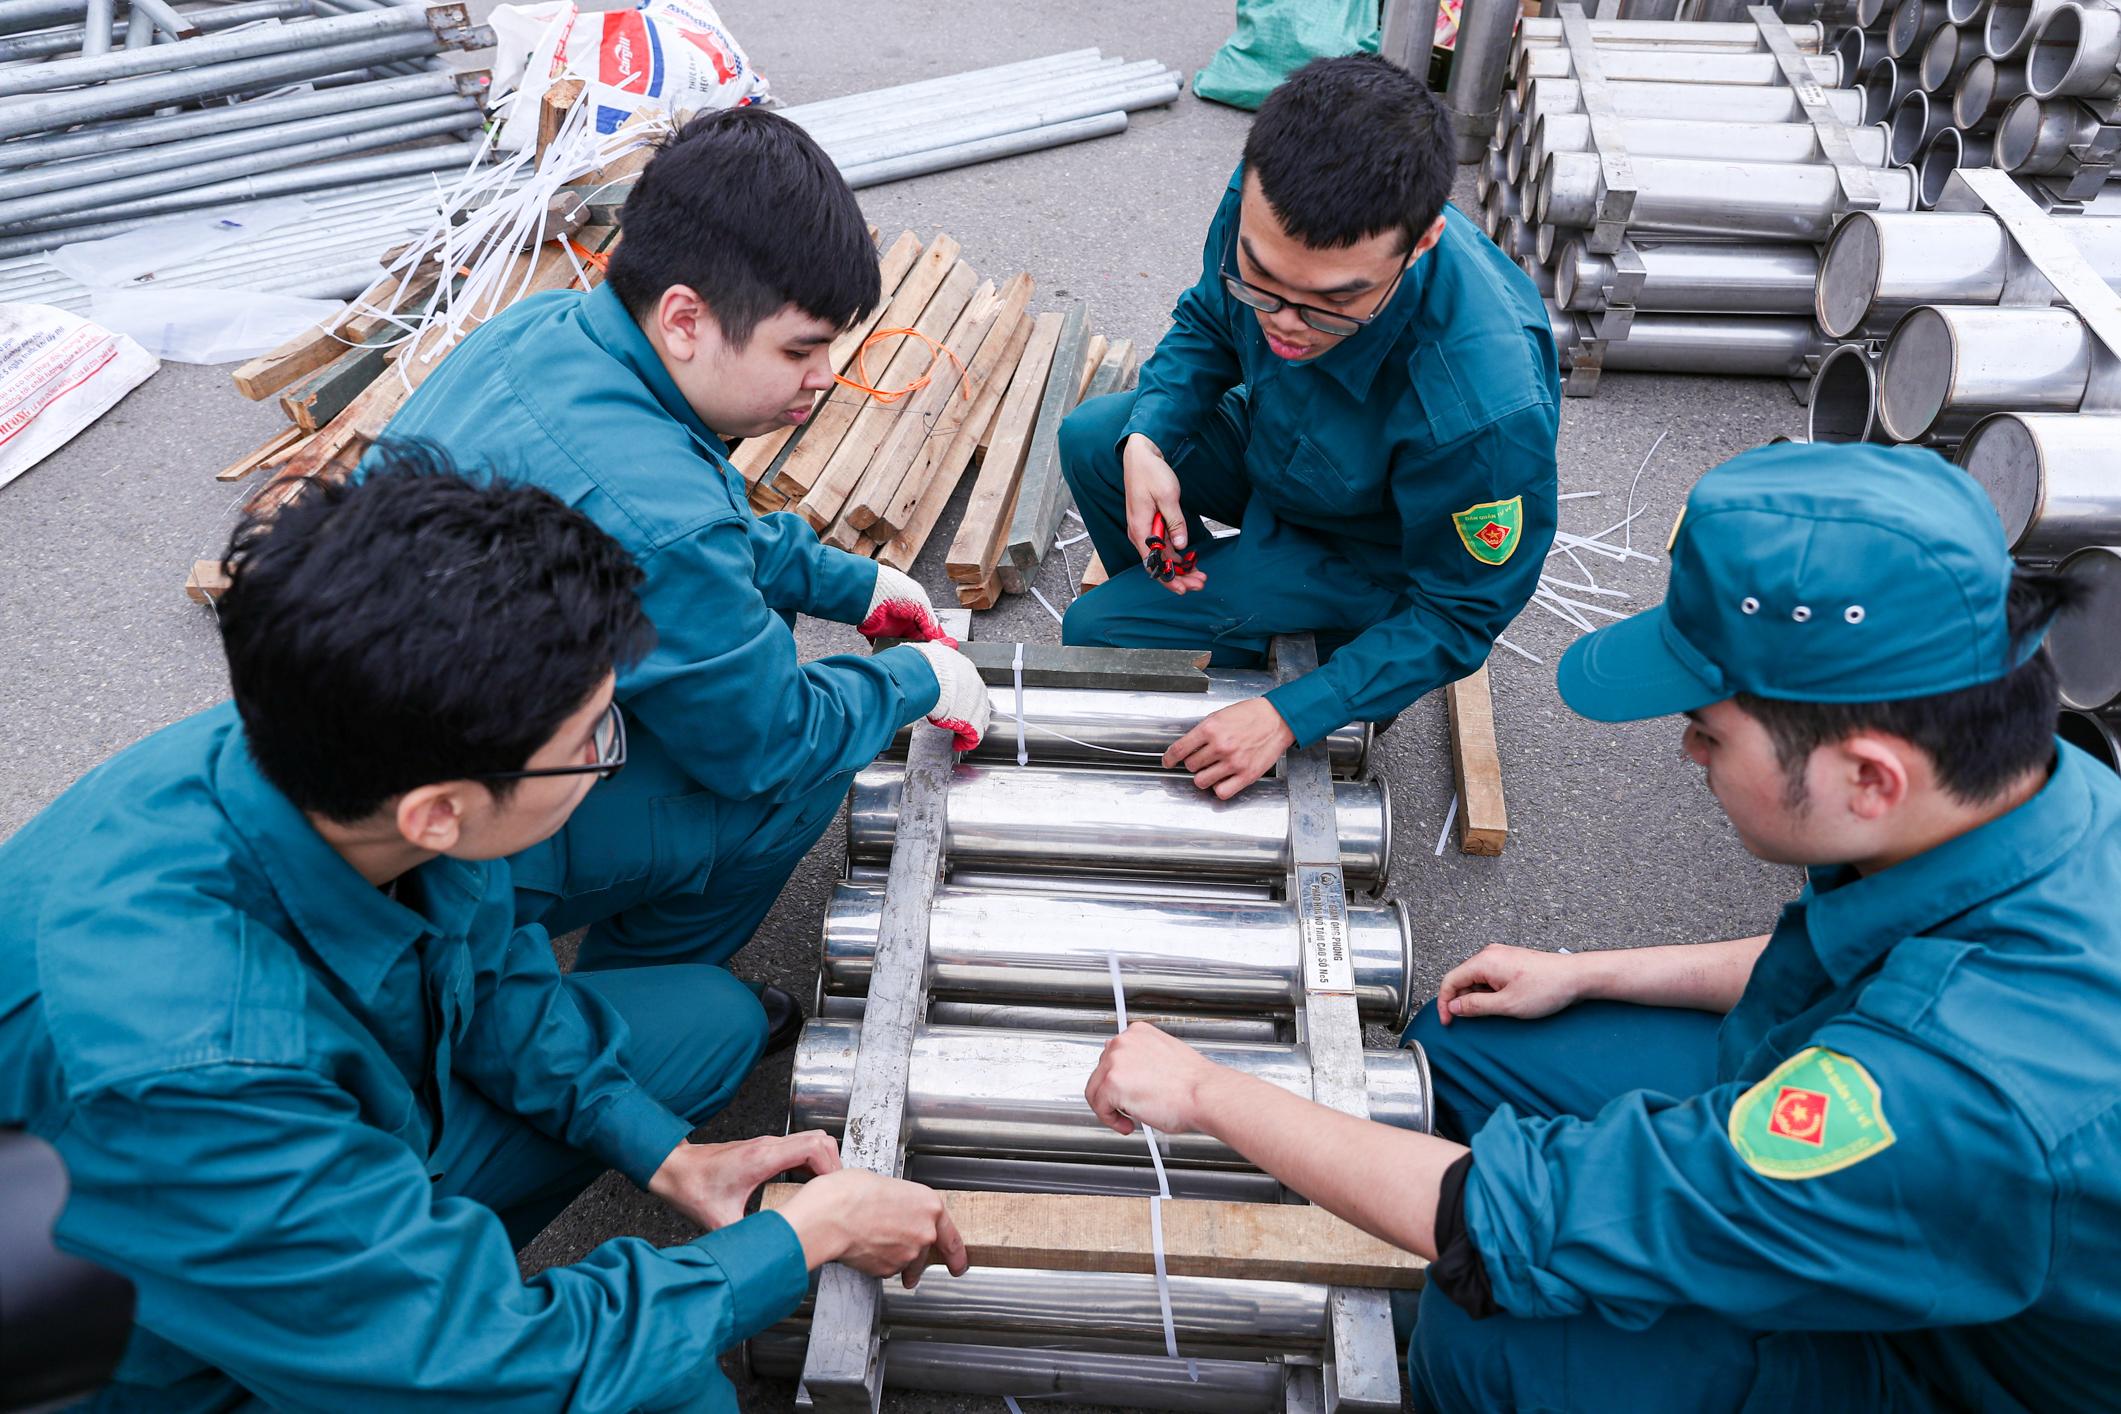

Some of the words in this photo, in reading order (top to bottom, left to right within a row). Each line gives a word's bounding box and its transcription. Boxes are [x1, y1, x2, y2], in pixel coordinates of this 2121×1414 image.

[616, 36, 633, 75] Cargill
[36, 339, 47, 348] khi
[35, 361, 50, 372] thay
[1317, 942, 1326, 956] CAO
[1332, 937, 1344, 961] PHÓNG
[1318, 958, 1331, 968] SỐ
